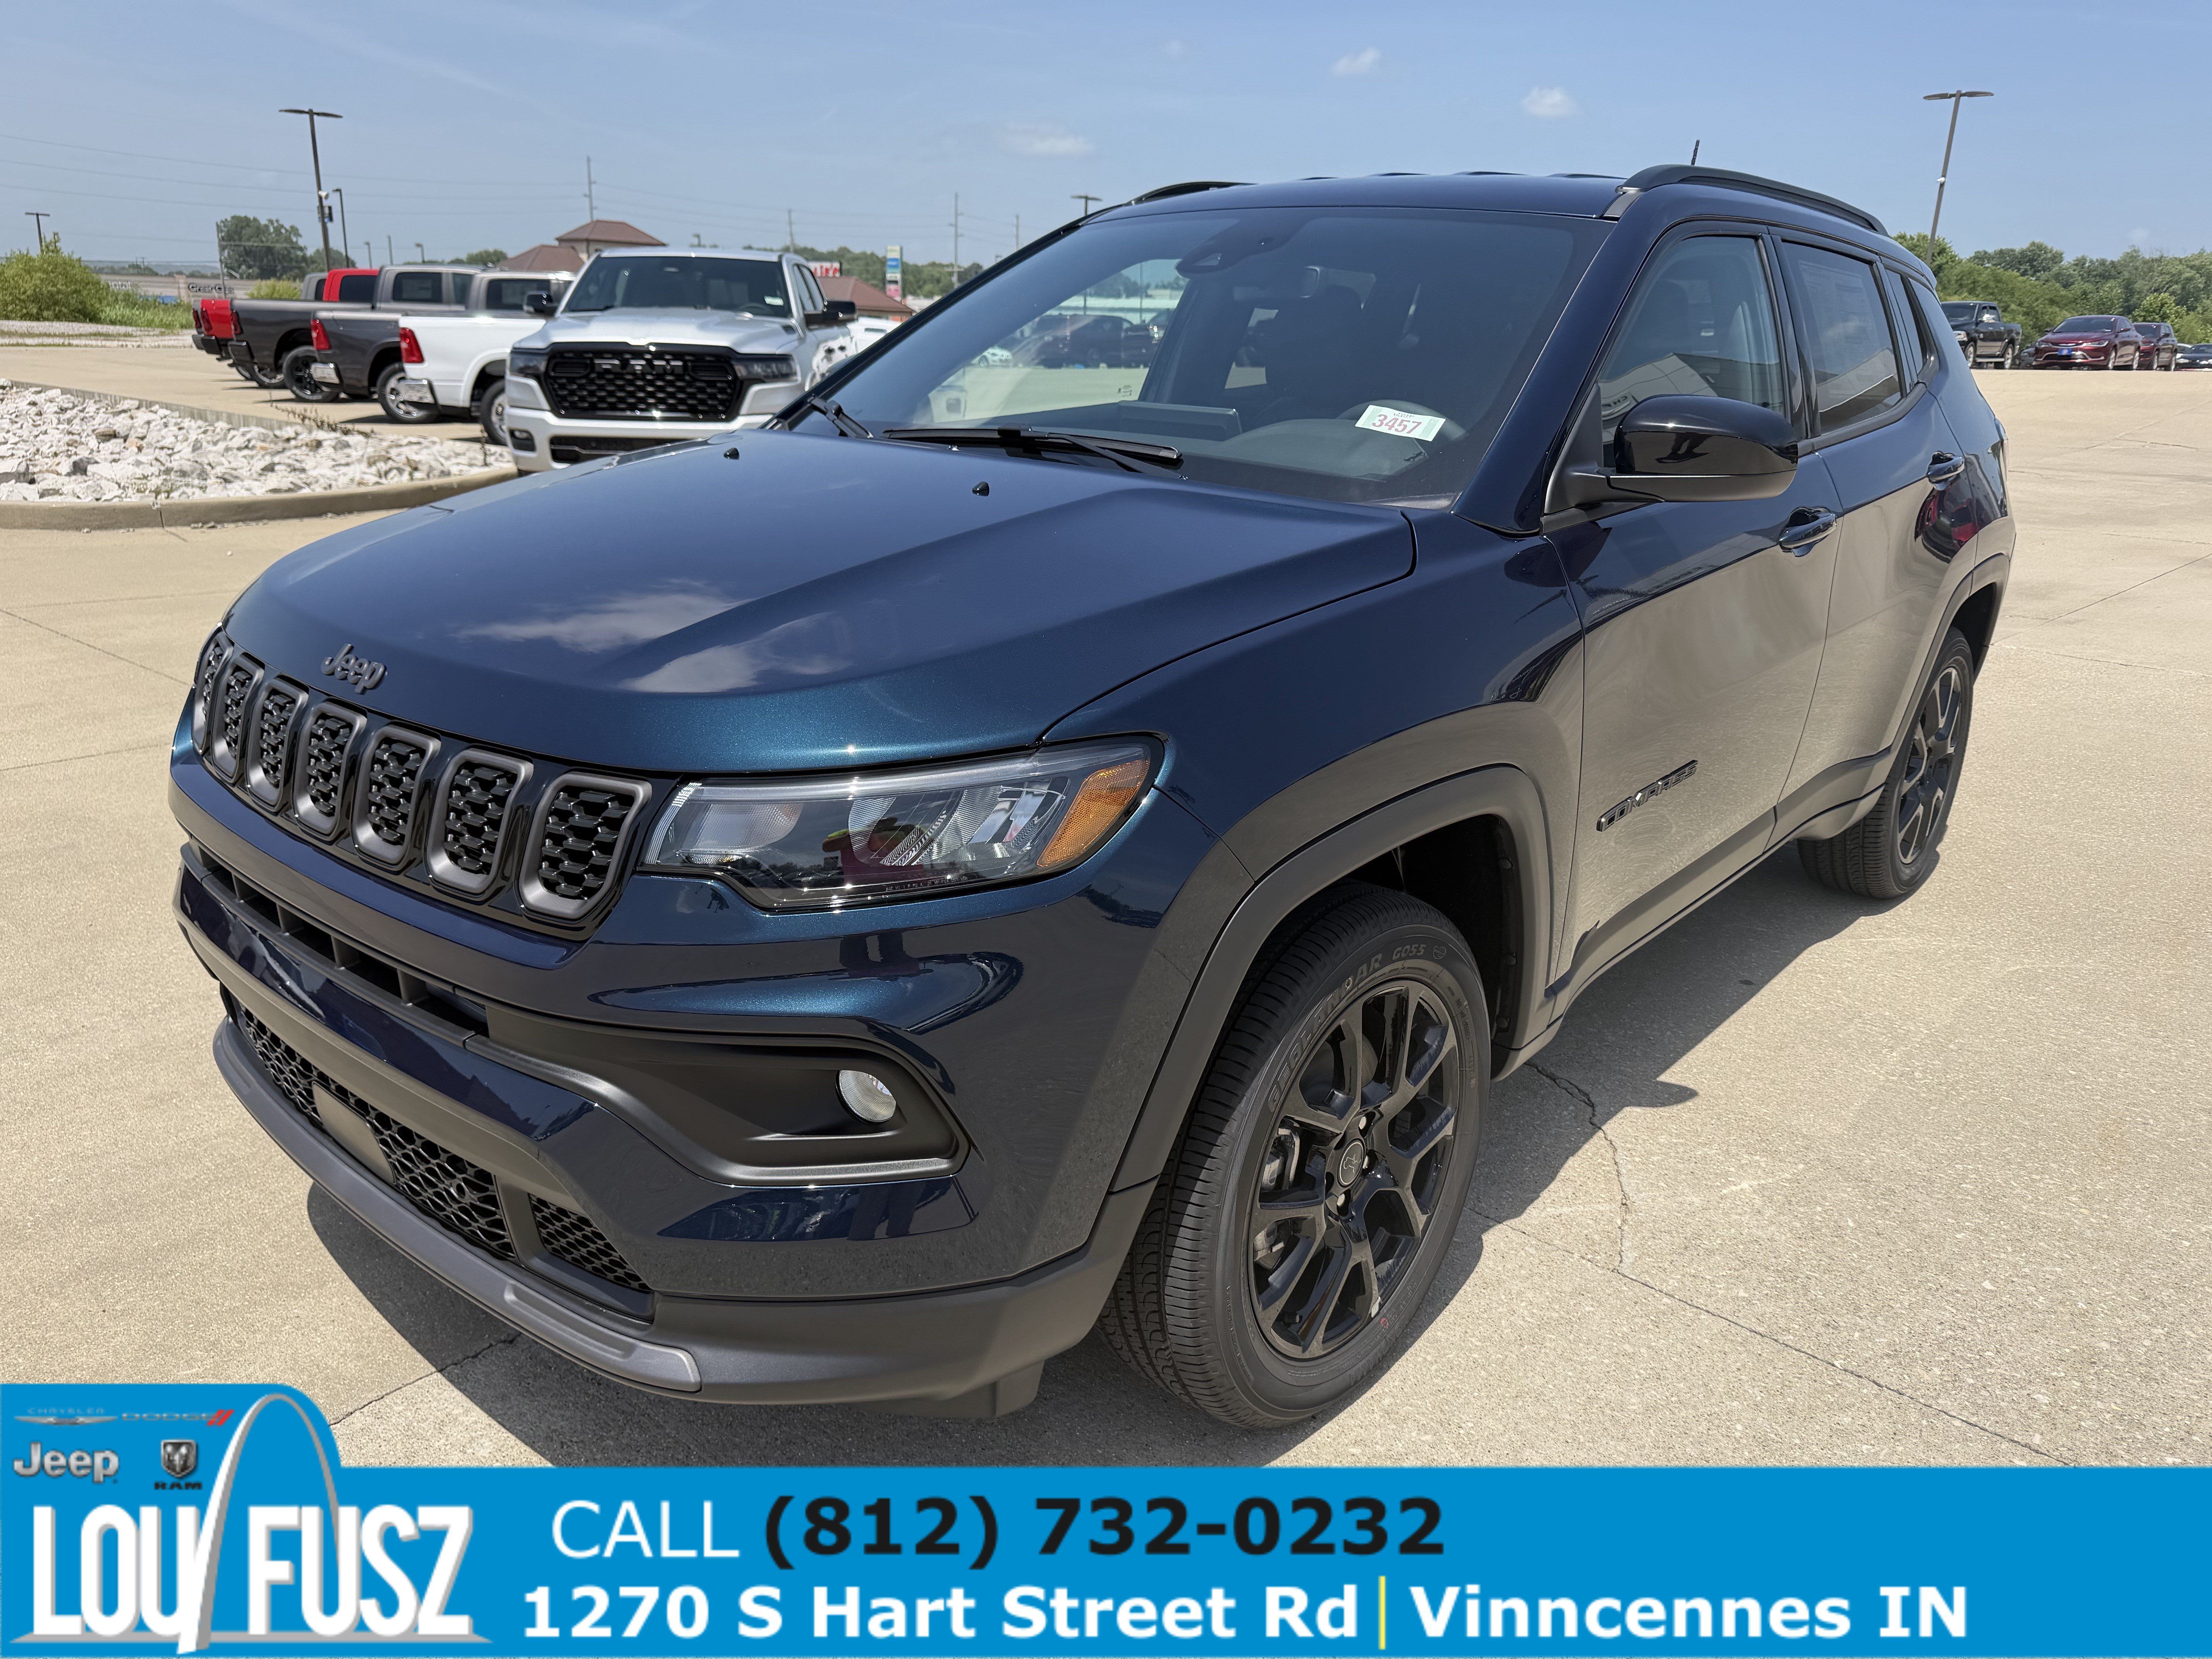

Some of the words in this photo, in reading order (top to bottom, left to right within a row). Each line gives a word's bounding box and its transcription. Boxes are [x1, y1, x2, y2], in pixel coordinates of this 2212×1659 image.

[592, 358, 684, 374] RAM
[1372, 414, 1422, 434] 3457
[321, 643, 387, 695] Jeep
[1596, 759, 1698, 832] COMPASS
[1267, 952, 1382, 1113] GEOLANDAR
